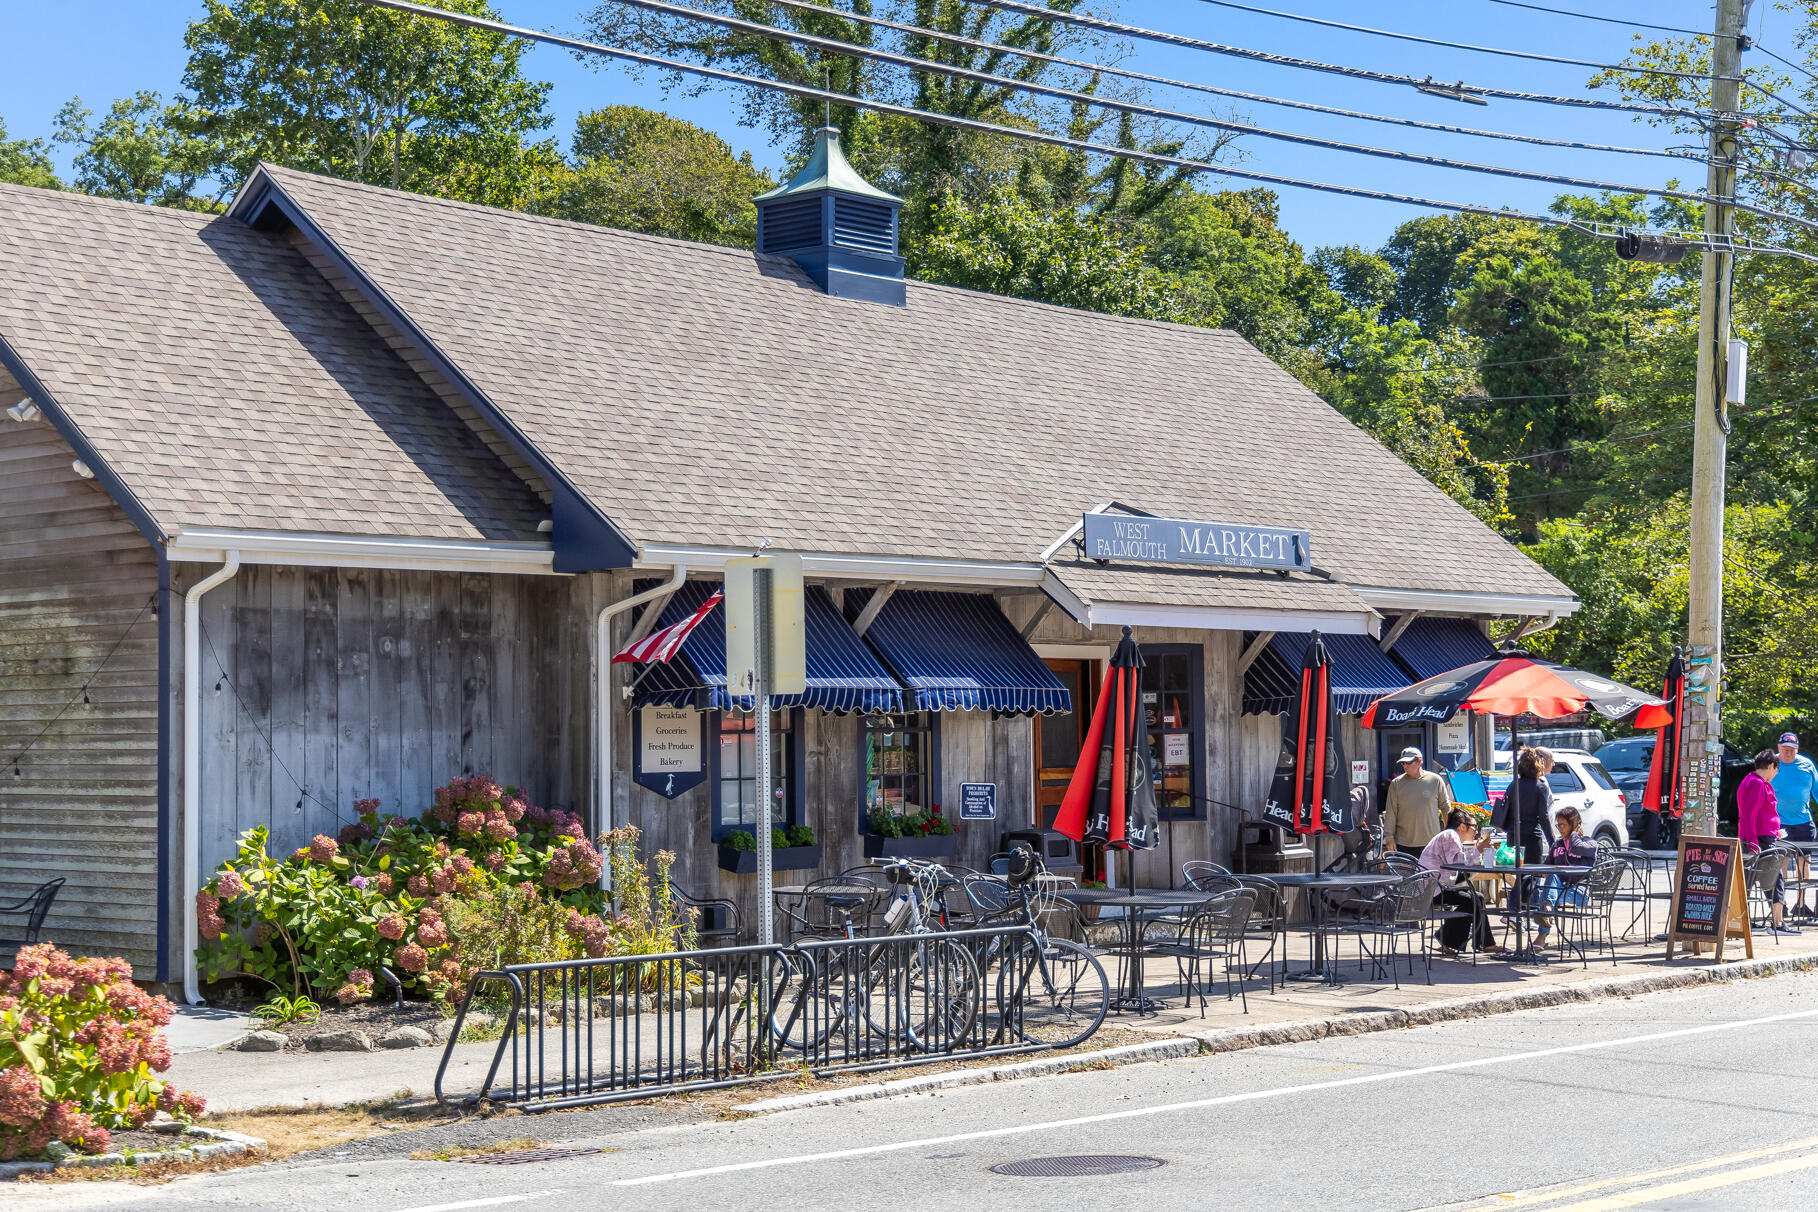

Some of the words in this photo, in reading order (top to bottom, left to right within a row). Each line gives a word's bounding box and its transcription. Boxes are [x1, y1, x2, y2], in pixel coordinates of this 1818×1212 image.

[1113, 521, 1150, 540] WEST
[1096, 538, 1167, 560] FALMOUTH
[1178, 526, 1289, 560] MARKET
[656, 711, 687, 719] Breakfast
[1416, 705, 1449, 719] Head
[655, 726, 688, 735] Groceries
[648, 742, 666, 751] Fresh
[668, 741, 695, 750] Produce
[660, 757, 683, 768] Bakery
[1686, 848, 1701, 862] PIE
[1712, 850, 1728, 865] SKY
[1687, 875, 1719, 885] COFFEE
